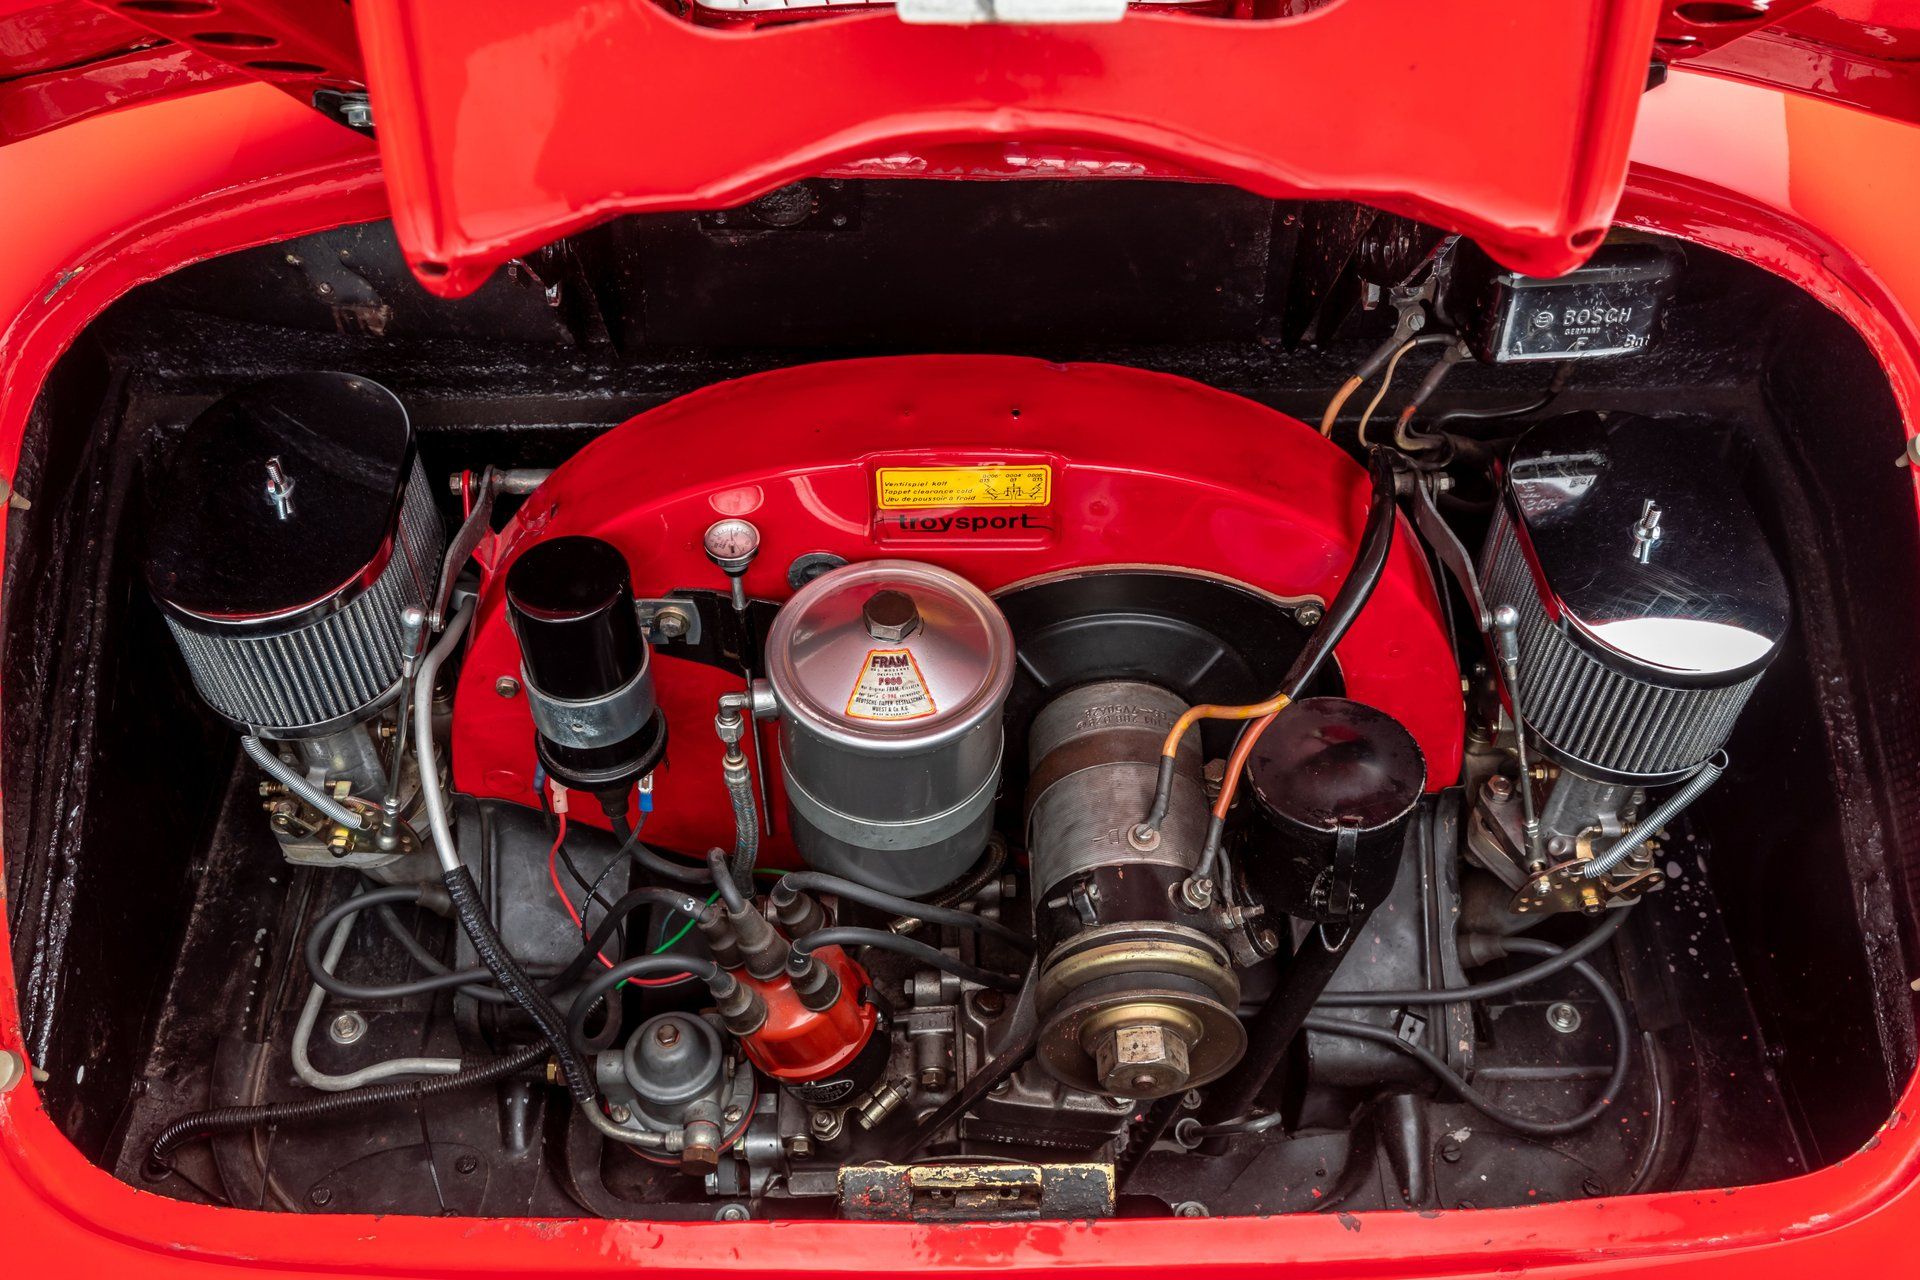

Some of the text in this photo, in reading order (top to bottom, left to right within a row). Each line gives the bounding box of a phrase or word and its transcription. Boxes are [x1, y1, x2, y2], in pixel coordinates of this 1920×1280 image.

[1563, 307, 1632, 327] BOSCH
[899, 512, 1048, 533] troysport
[871, 654, 909, 668] FRAM
[683, 897, 696, 911] 3
